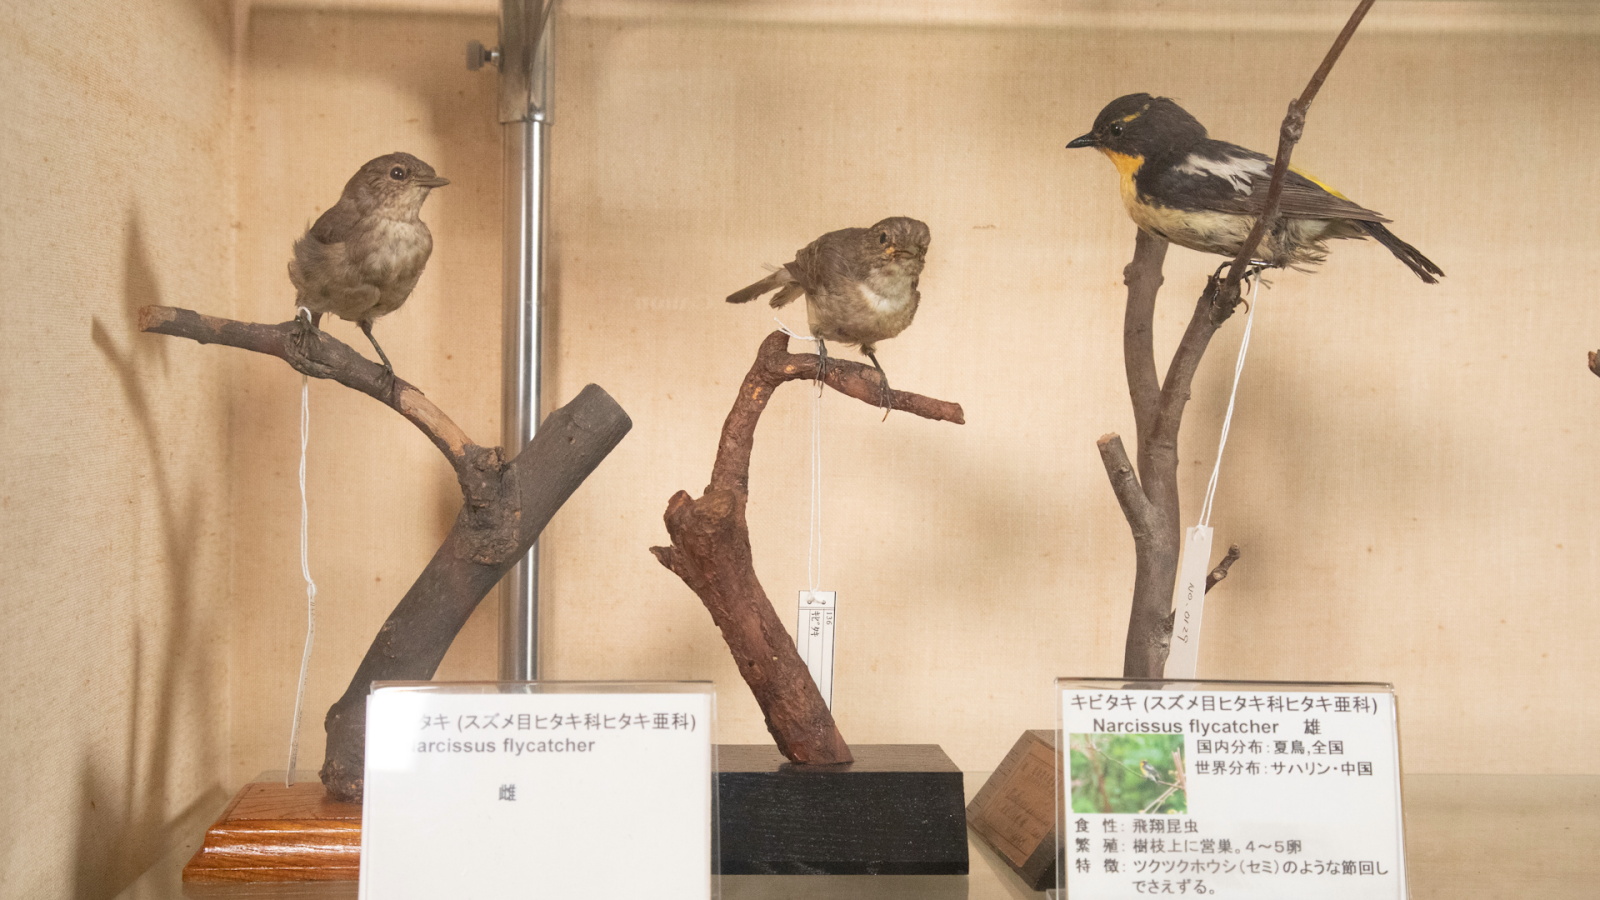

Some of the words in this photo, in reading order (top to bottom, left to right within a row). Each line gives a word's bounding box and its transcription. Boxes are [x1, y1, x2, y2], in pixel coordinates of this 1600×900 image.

[1070, 694, 1137, 711] キビタキ
[420, 712, 451, 731] タキ
[1093, 719, 1184, 735] Narcissus
[1189, 718, 1280, 737] flycatcher
[1303, 718, 1322, 735] 雄
[416, 738, 497, 754] arcissus
[503, 738, 596, 756] flycatcher
[499, 784, 517, 802] 雌
[1132, 879, 1216, 895] でさえずる。
